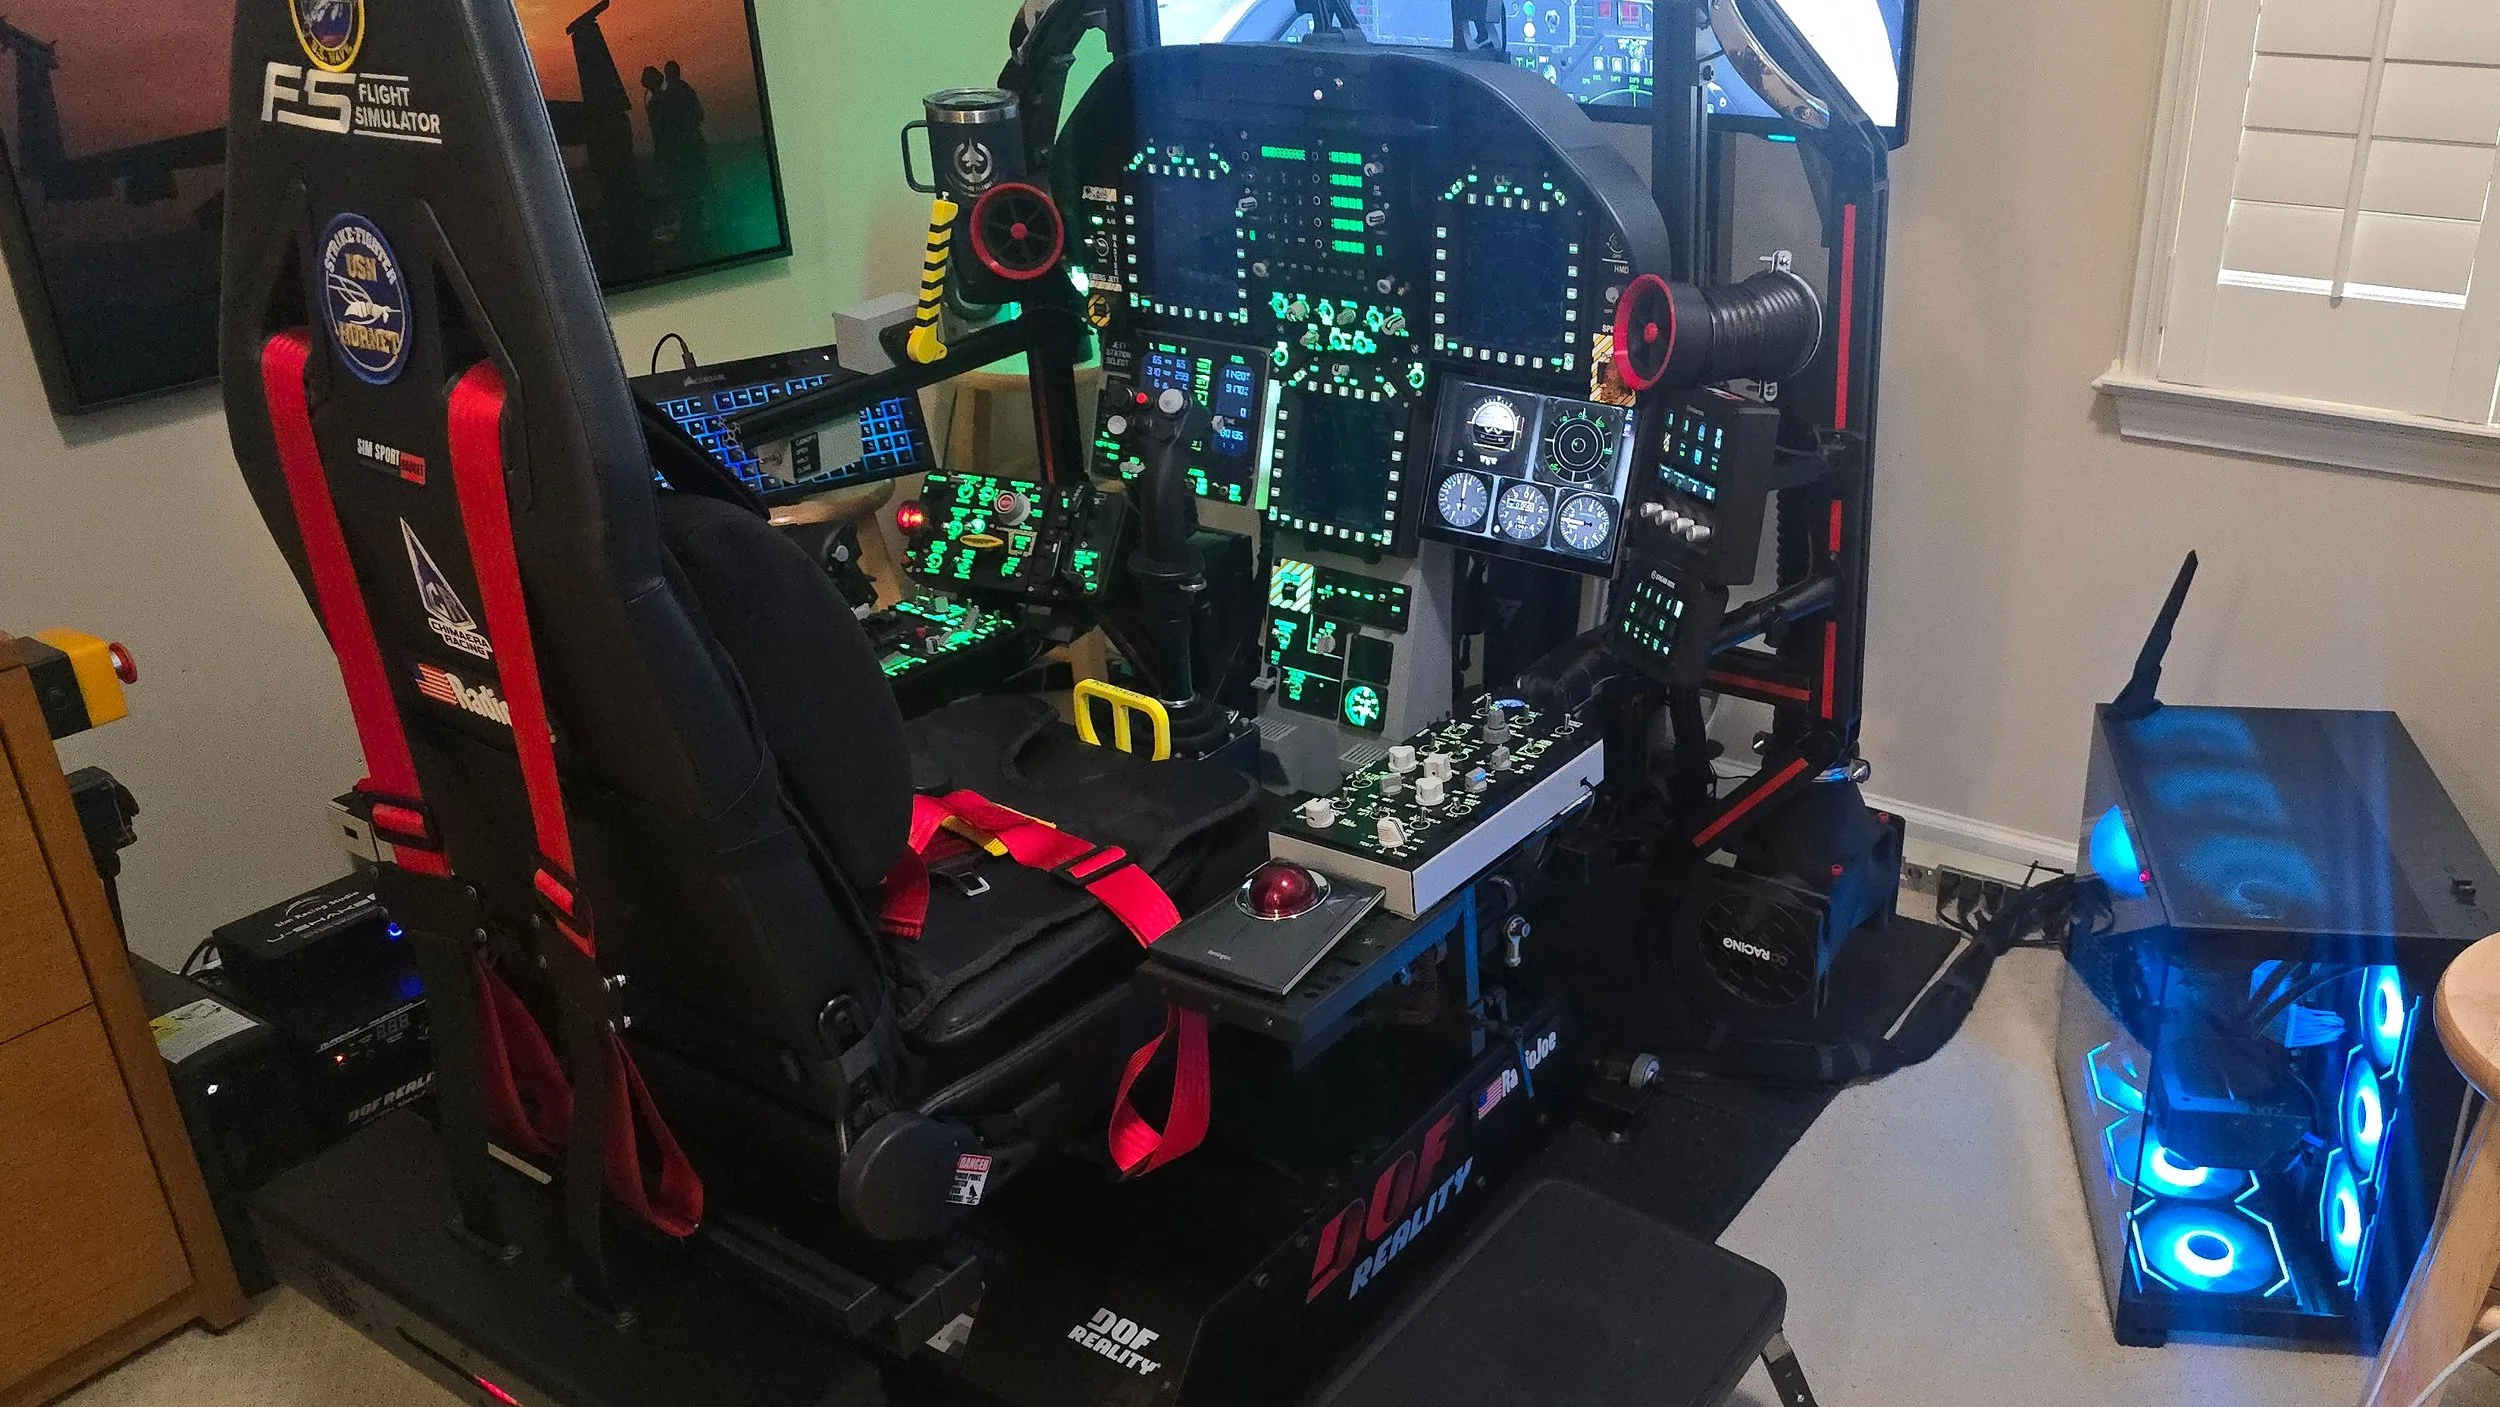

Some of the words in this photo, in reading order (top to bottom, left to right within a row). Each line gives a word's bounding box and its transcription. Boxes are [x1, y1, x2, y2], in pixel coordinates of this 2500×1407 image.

[261, 61, 356, 134] FS
[358, 83, 410, 107] FLIGHT
[354, 106, 441, 134] SIMULATOR
[344, 253, 378, 282] USN
[337, 320, 400, 357] HORNET
[357, 438, 373, 457] SIM
[374, 443, 401, 466] SPORT
[430, 620, 489, 648] CHIMAERA
[445, 634, 488, 656] RACING
[1722, 937, 1771, 961] RACING
[1501, 1031, 1557, 1098] RaioJoe
[959, 1156, 990, 1171] DANGER
[1306, 1107, 1457, 1304] DOF
[1348, 1156, 1474, 1301] REALITY
[1086, 1307, 1160, 1350] DOF
[1067, 1325, 1160, 1375] REALITY
